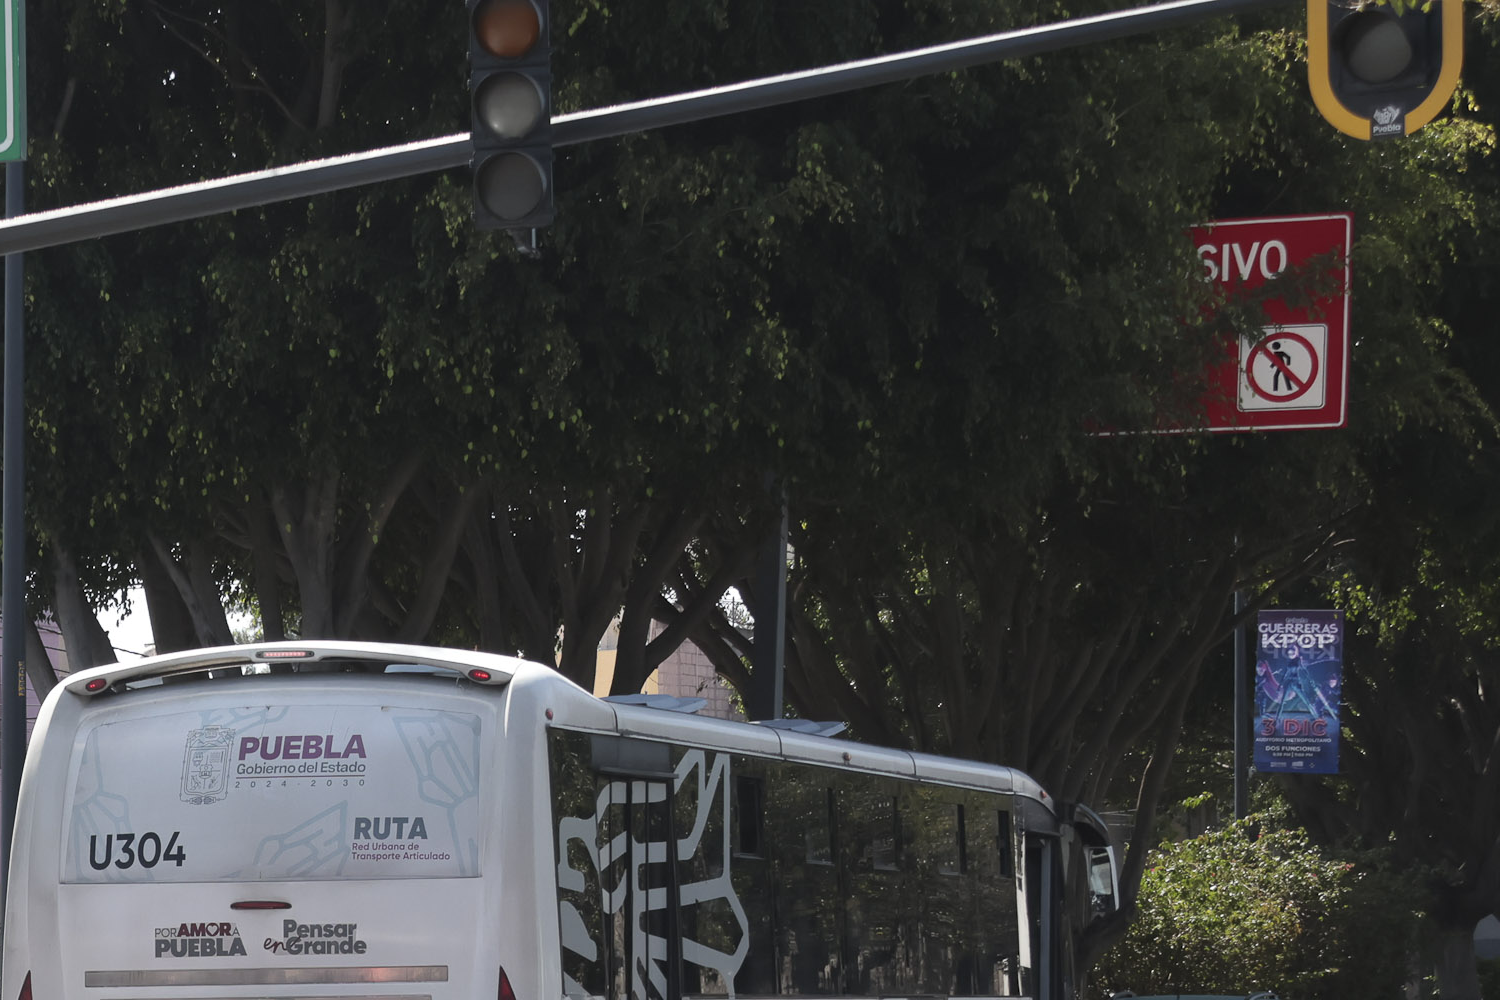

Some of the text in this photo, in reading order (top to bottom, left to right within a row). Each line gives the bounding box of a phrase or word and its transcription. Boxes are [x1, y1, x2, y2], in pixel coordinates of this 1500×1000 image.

[1258, 623, 1338, 634] GUERRERAS
[1261, 633, 1336, 649] KPOP
[1261, 718, 1328, 737] 3 DIC
[238, 734, 367, 761] PUEBLA
[236, 761, 366, 776] Gobierno del Estado
[353, 817, 428, 840] RUTA
[90, 831, 186, 870] U304
[352, 842, 419, 851] Red Urbana de
[352, 851, 450, 861] Transporte Articulado
[155, 922, 240, 938] POR AMOR A
[283, 919, 357, 938] Pensar
[154, 937, 248, 958] PUEBLA
[264, 936, 367, 955] en Grande
